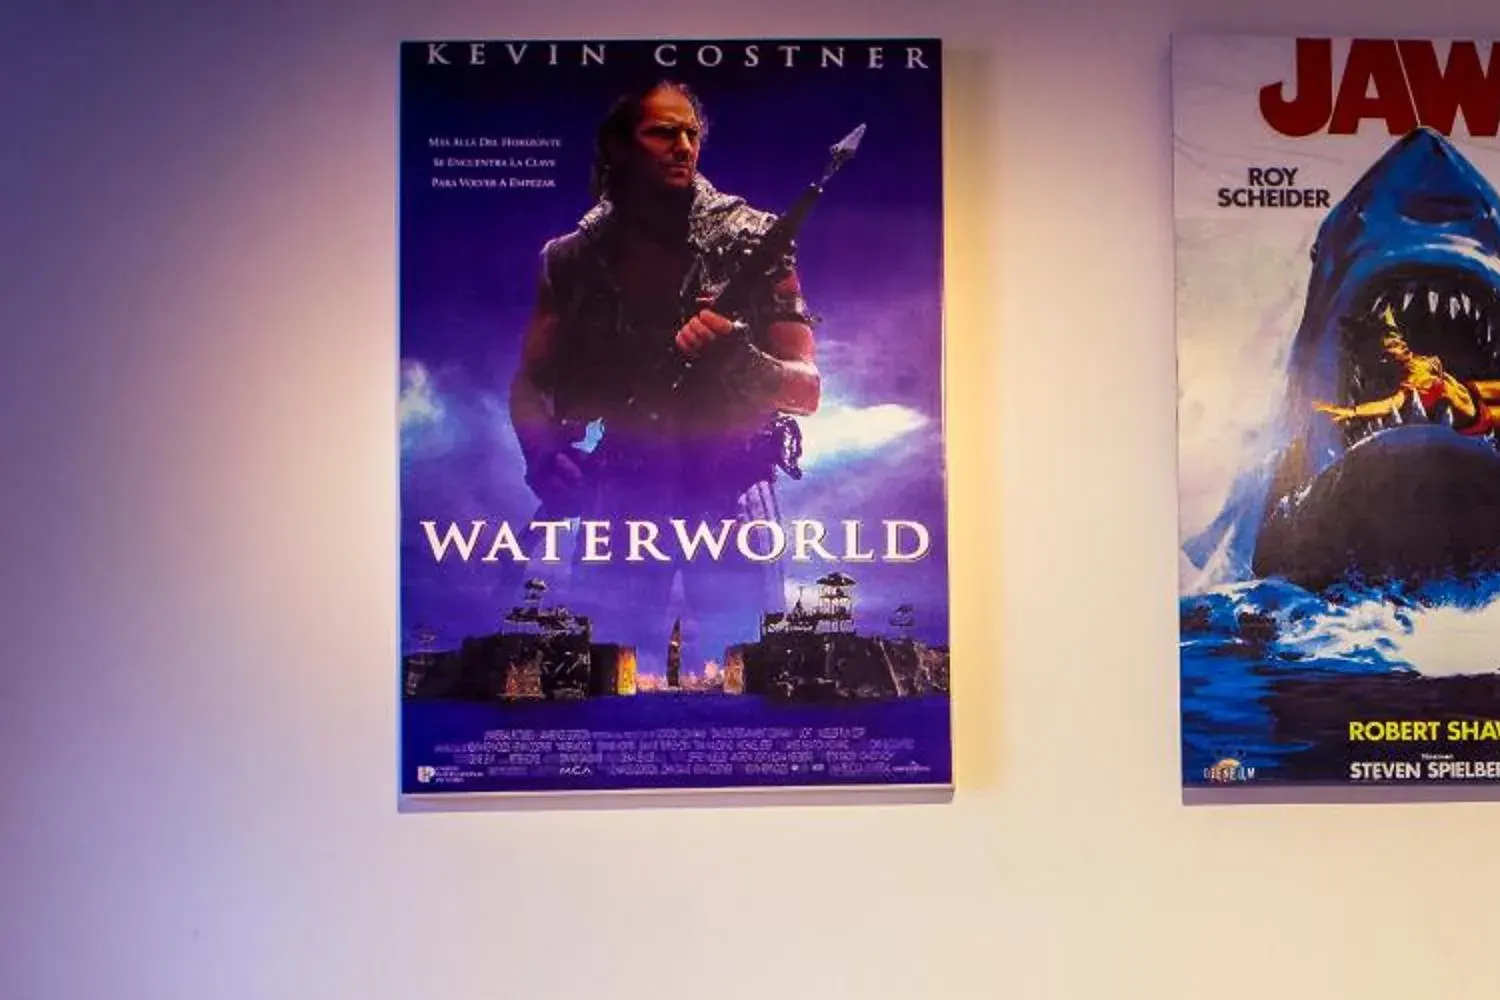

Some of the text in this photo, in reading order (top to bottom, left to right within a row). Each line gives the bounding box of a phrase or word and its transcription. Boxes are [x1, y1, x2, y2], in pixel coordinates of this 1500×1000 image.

[428, 44, 929, 70] KEVIN COSTNER
[1248, 167, 1299, 187] ROY
[1218, 188, 1330, 208] SCHEIDER
[420, 518, 933, 564] WATERWORLD
[1348, 720, 1441, 742] ROBERT
[1350, 761, 1422, 780] STEVEN
